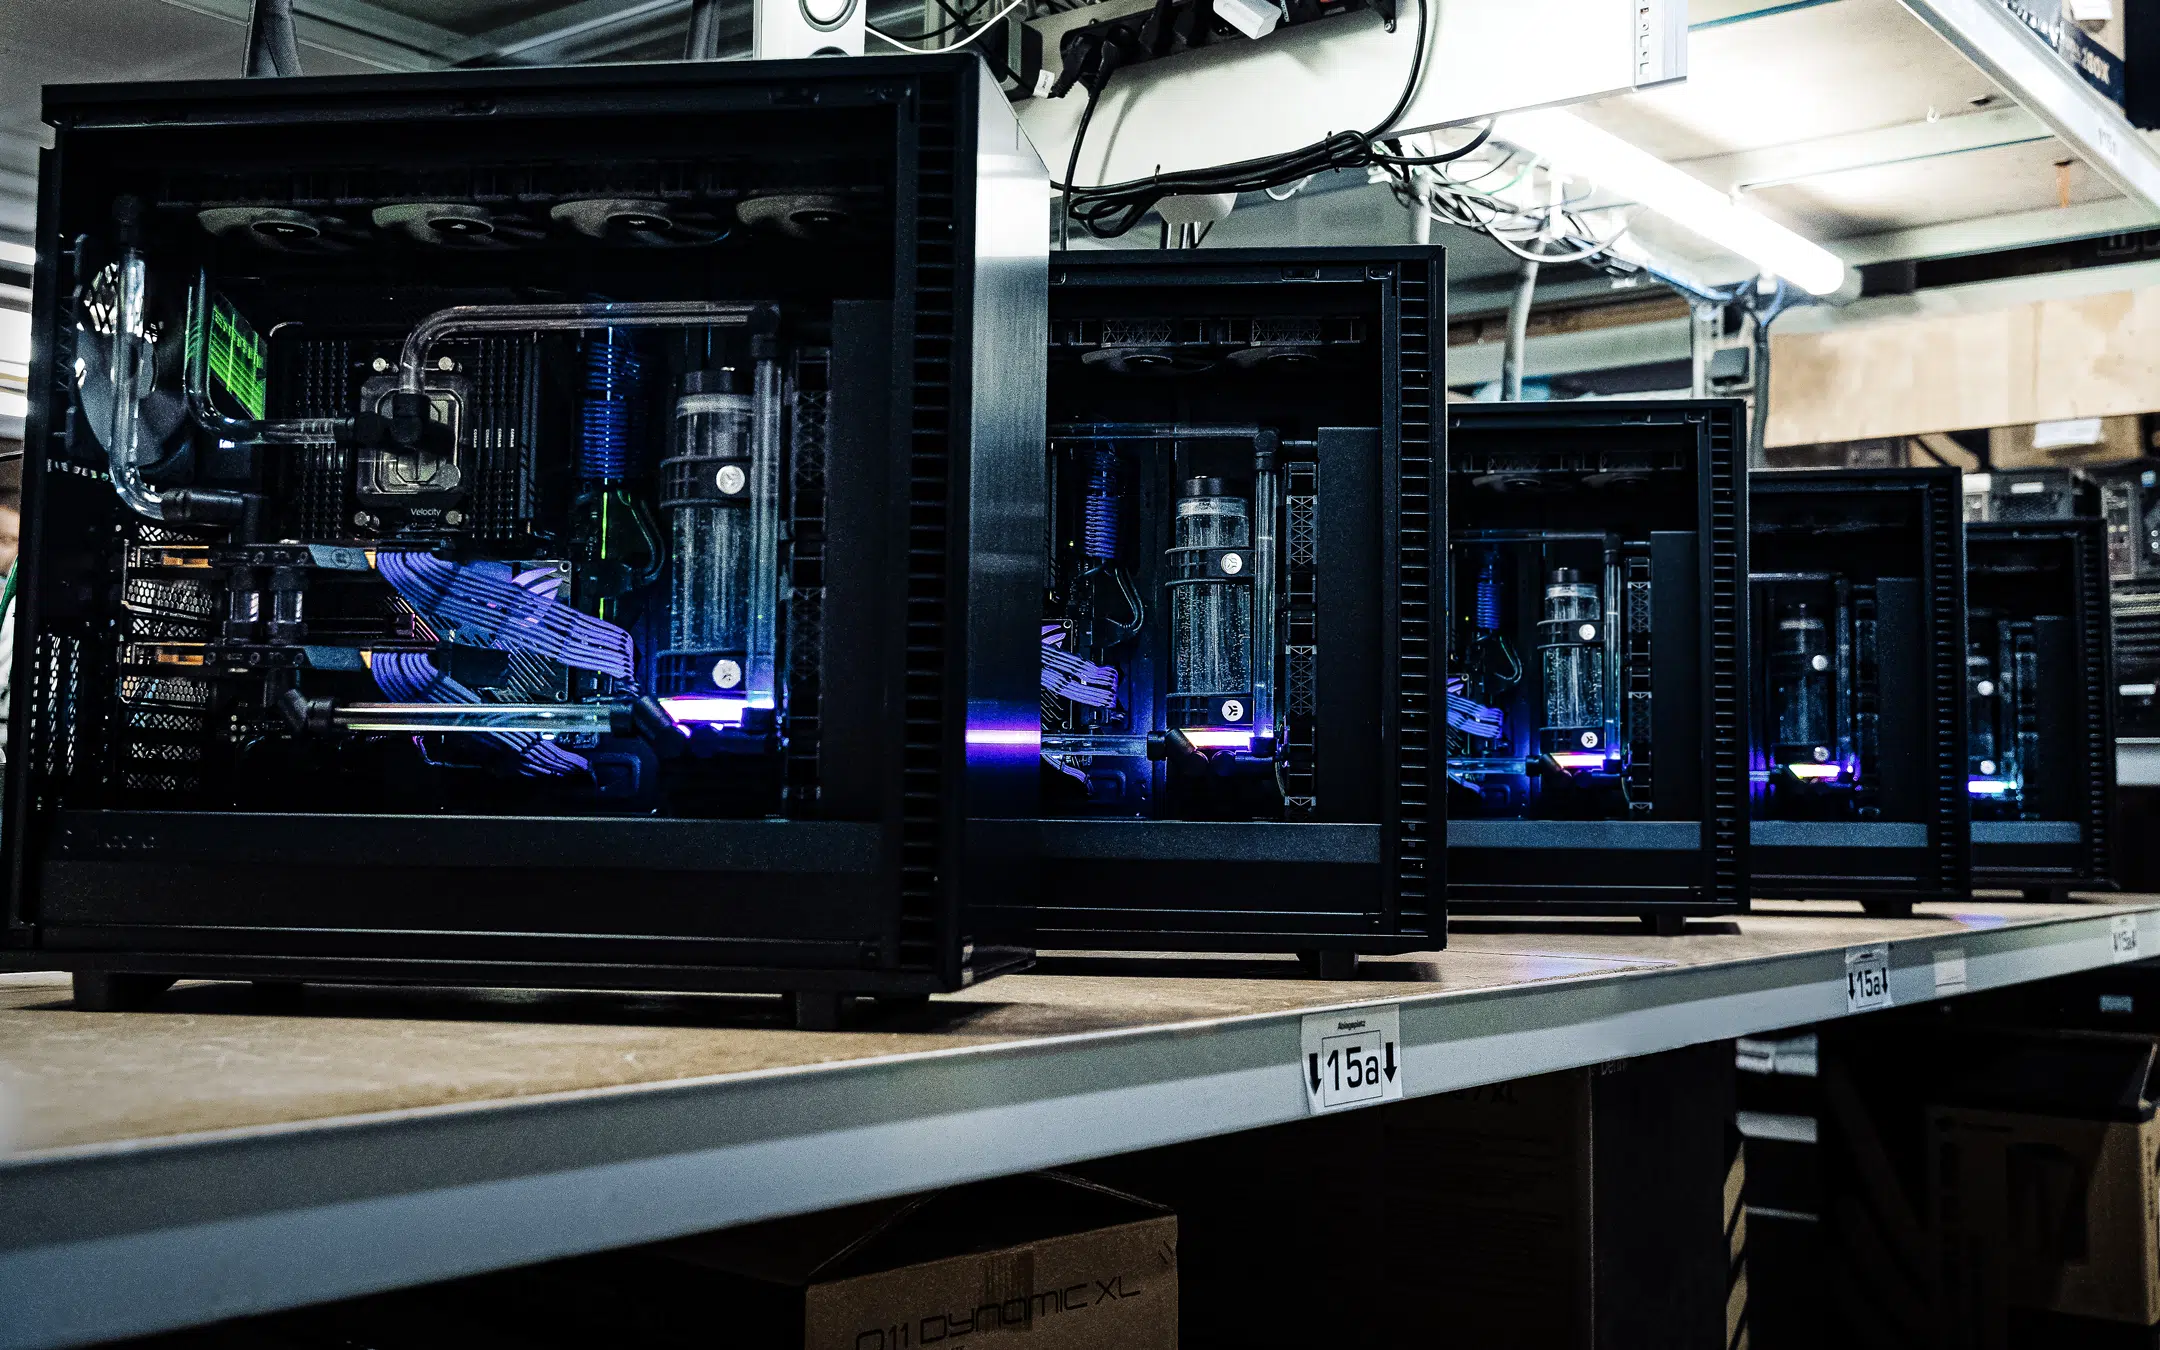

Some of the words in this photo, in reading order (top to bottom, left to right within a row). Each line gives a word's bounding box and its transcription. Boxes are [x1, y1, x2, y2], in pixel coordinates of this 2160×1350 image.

[410, 508, 442, 517] Velocity
[1856, 969, 1881, 998] 15a
[1326, 1045, 1380, 1092] 15a
[1094, 1275, 1142, 1305] XL
